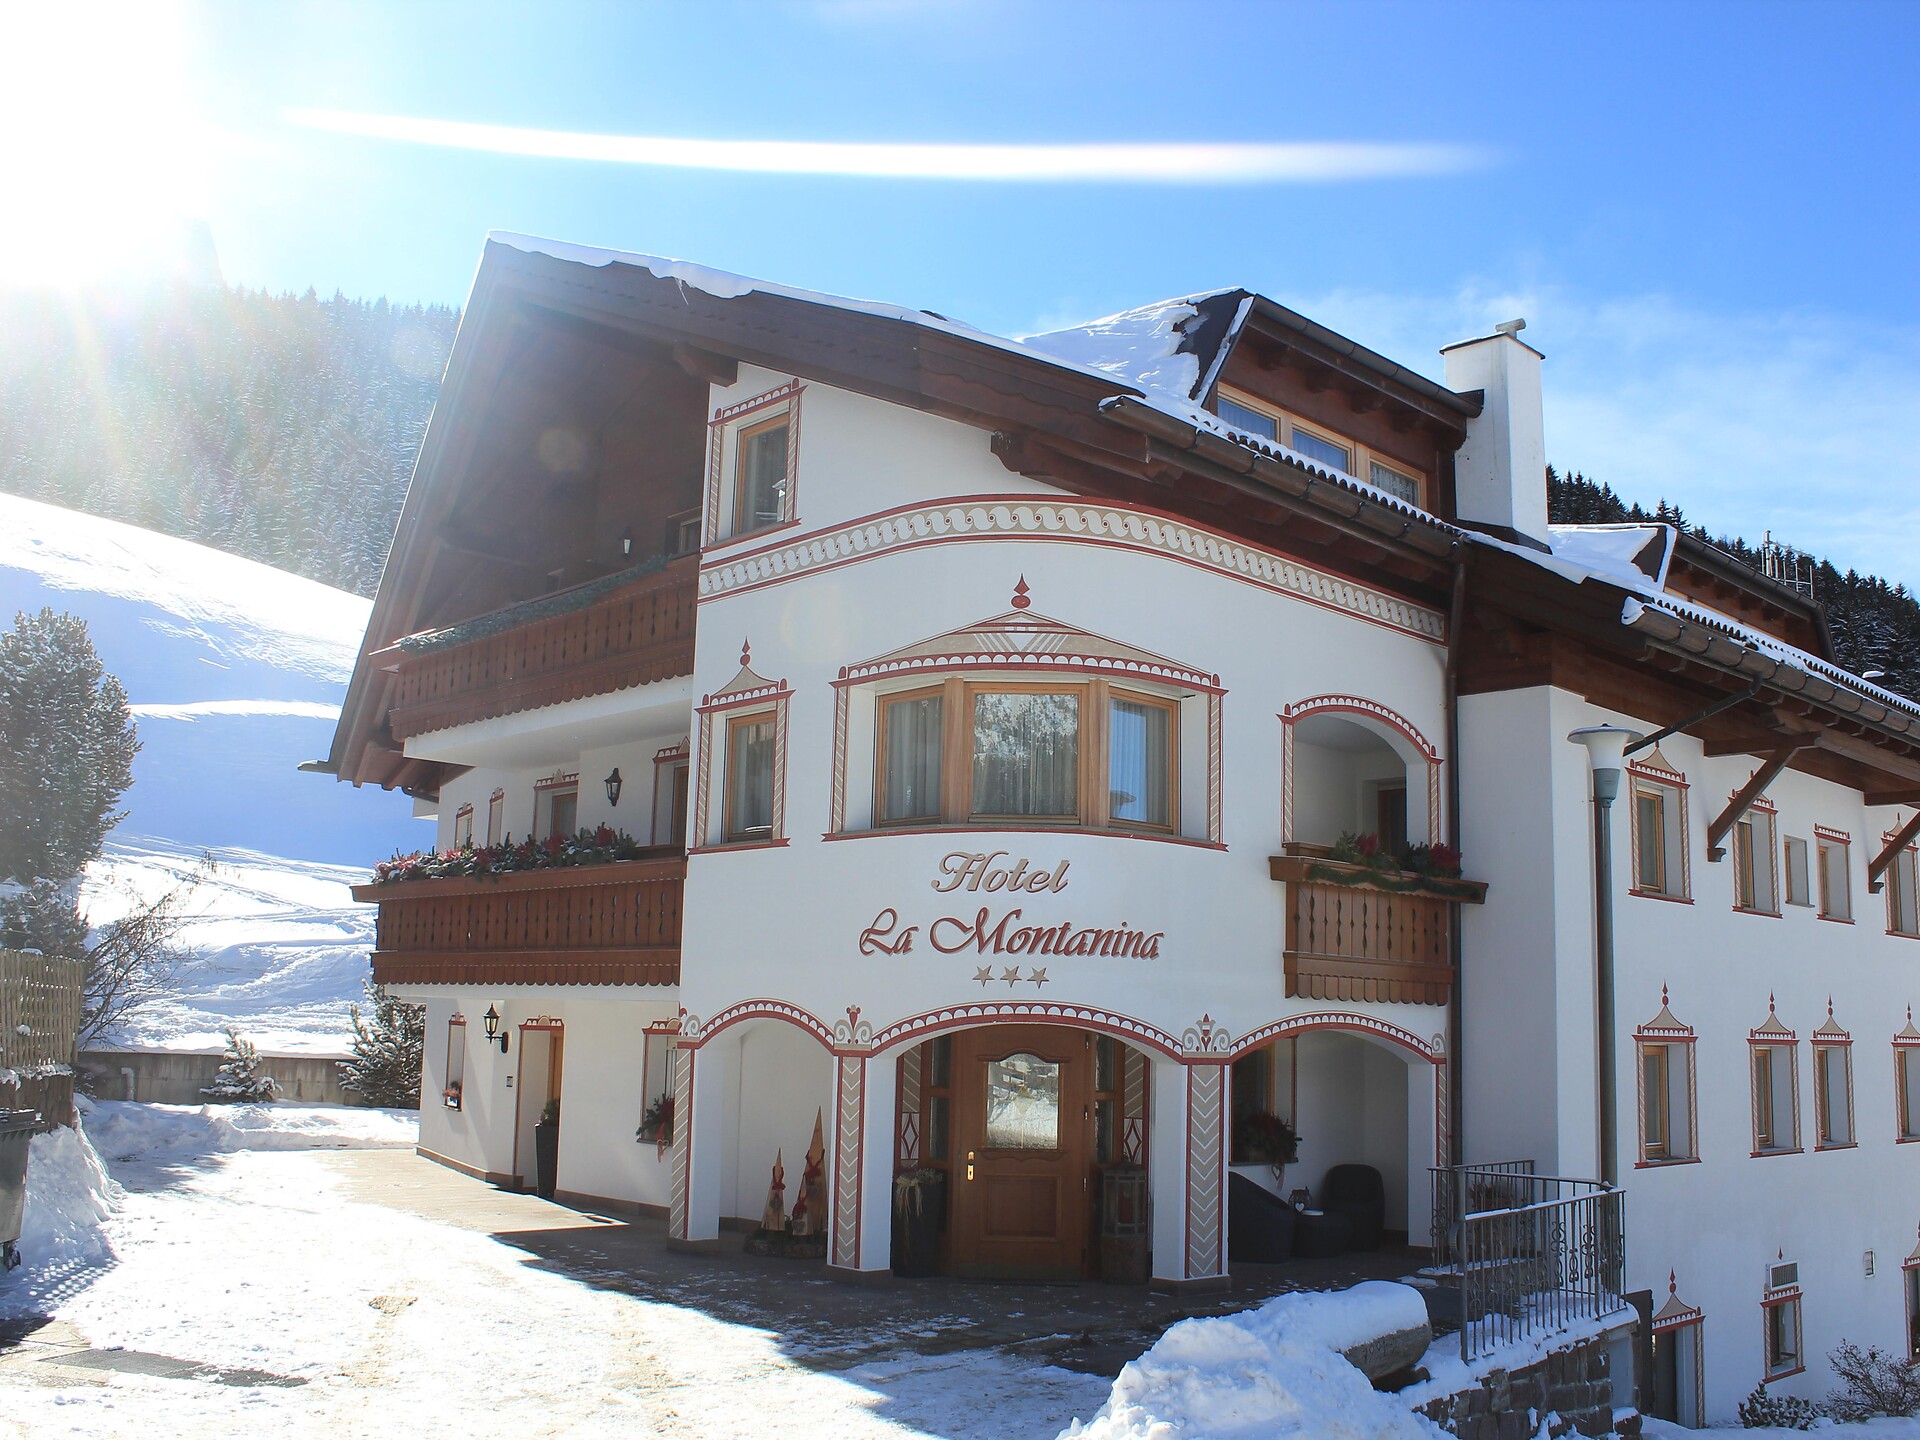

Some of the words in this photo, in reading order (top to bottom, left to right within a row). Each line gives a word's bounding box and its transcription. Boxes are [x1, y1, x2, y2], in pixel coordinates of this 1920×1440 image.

[931, 850, 1070, 893] Hotel
[859, 907, 919, 957] La
[929, 906, 1164, 959] Montanina
